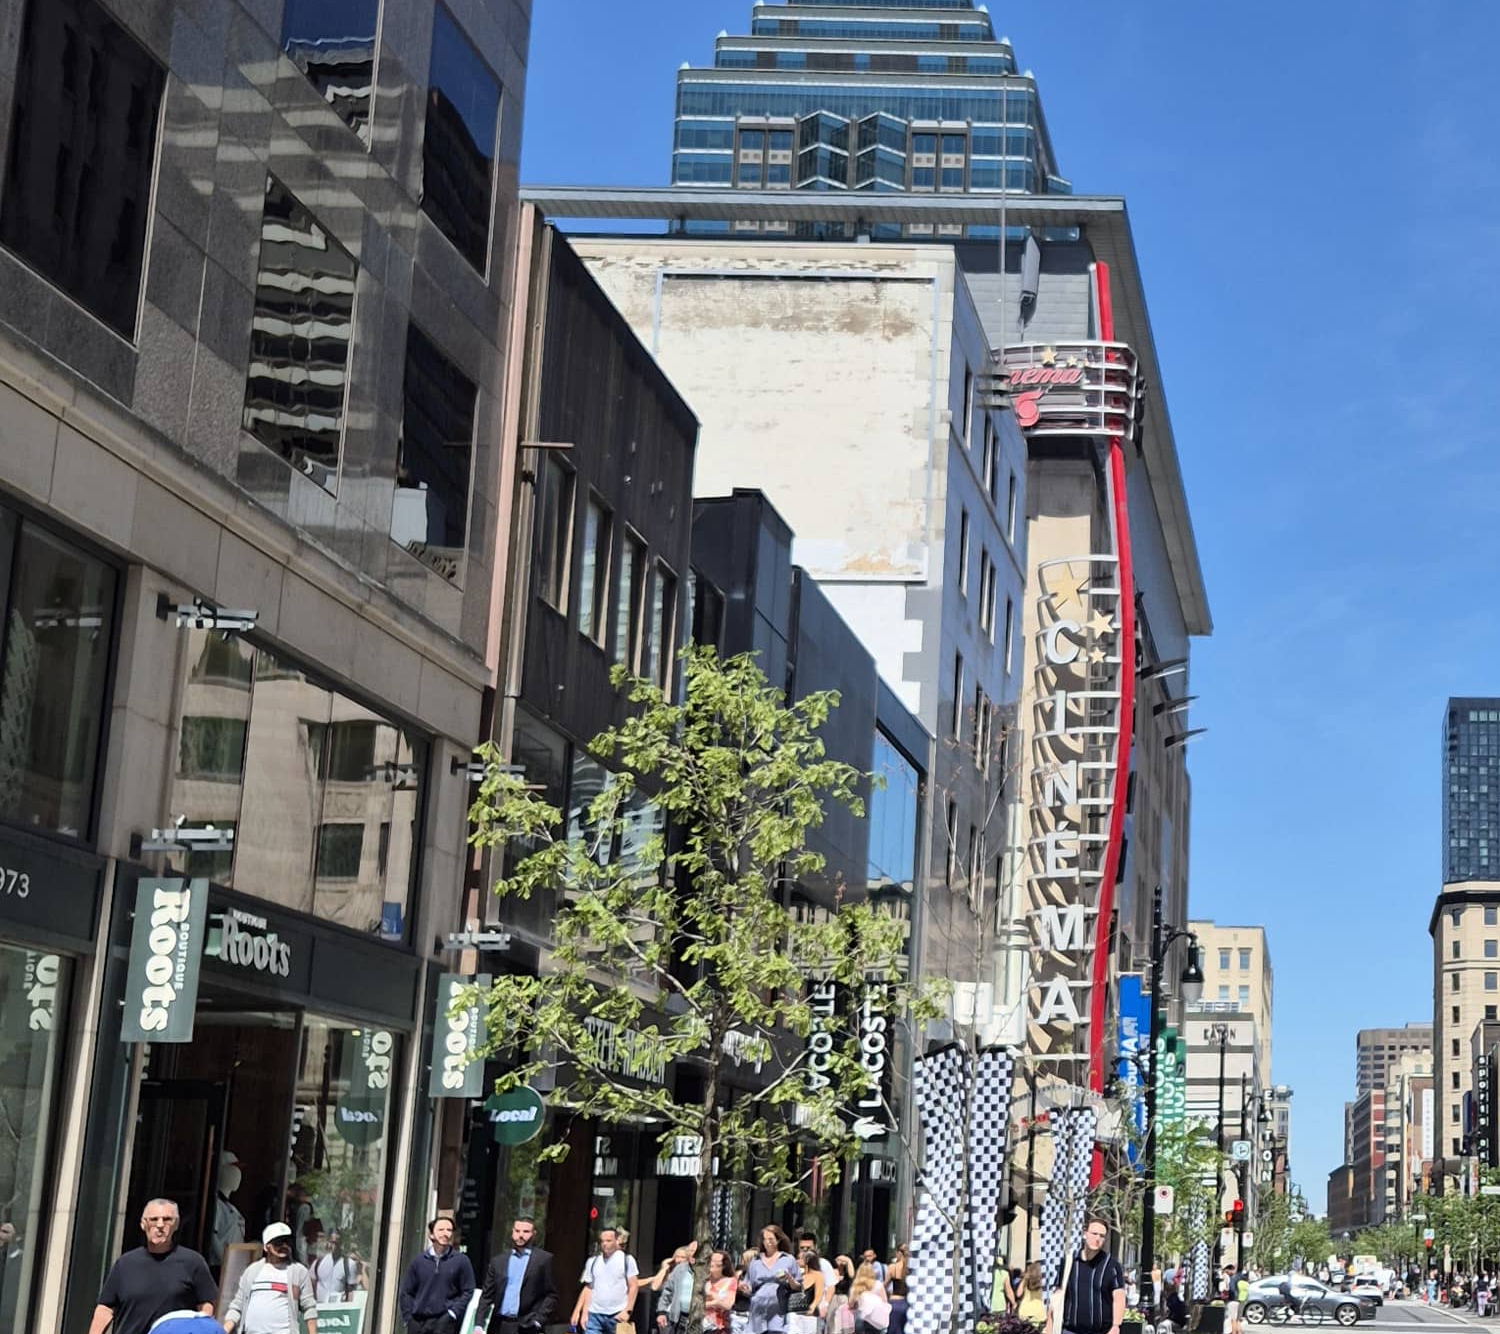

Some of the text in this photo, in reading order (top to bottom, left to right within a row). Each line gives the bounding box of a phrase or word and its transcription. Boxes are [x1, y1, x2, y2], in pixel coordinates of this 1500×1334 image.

[1038, 620, 1084, 1025] CINÉMA
[140, 888, 191, 1032] Roots
[174, 922, 191, 991] BOUTIQUE
[219, 916, 291, 978] Roots
[858, 983, 888, 1108] LACOSTE
[1262, 1089, 1273, 1182] EATON
